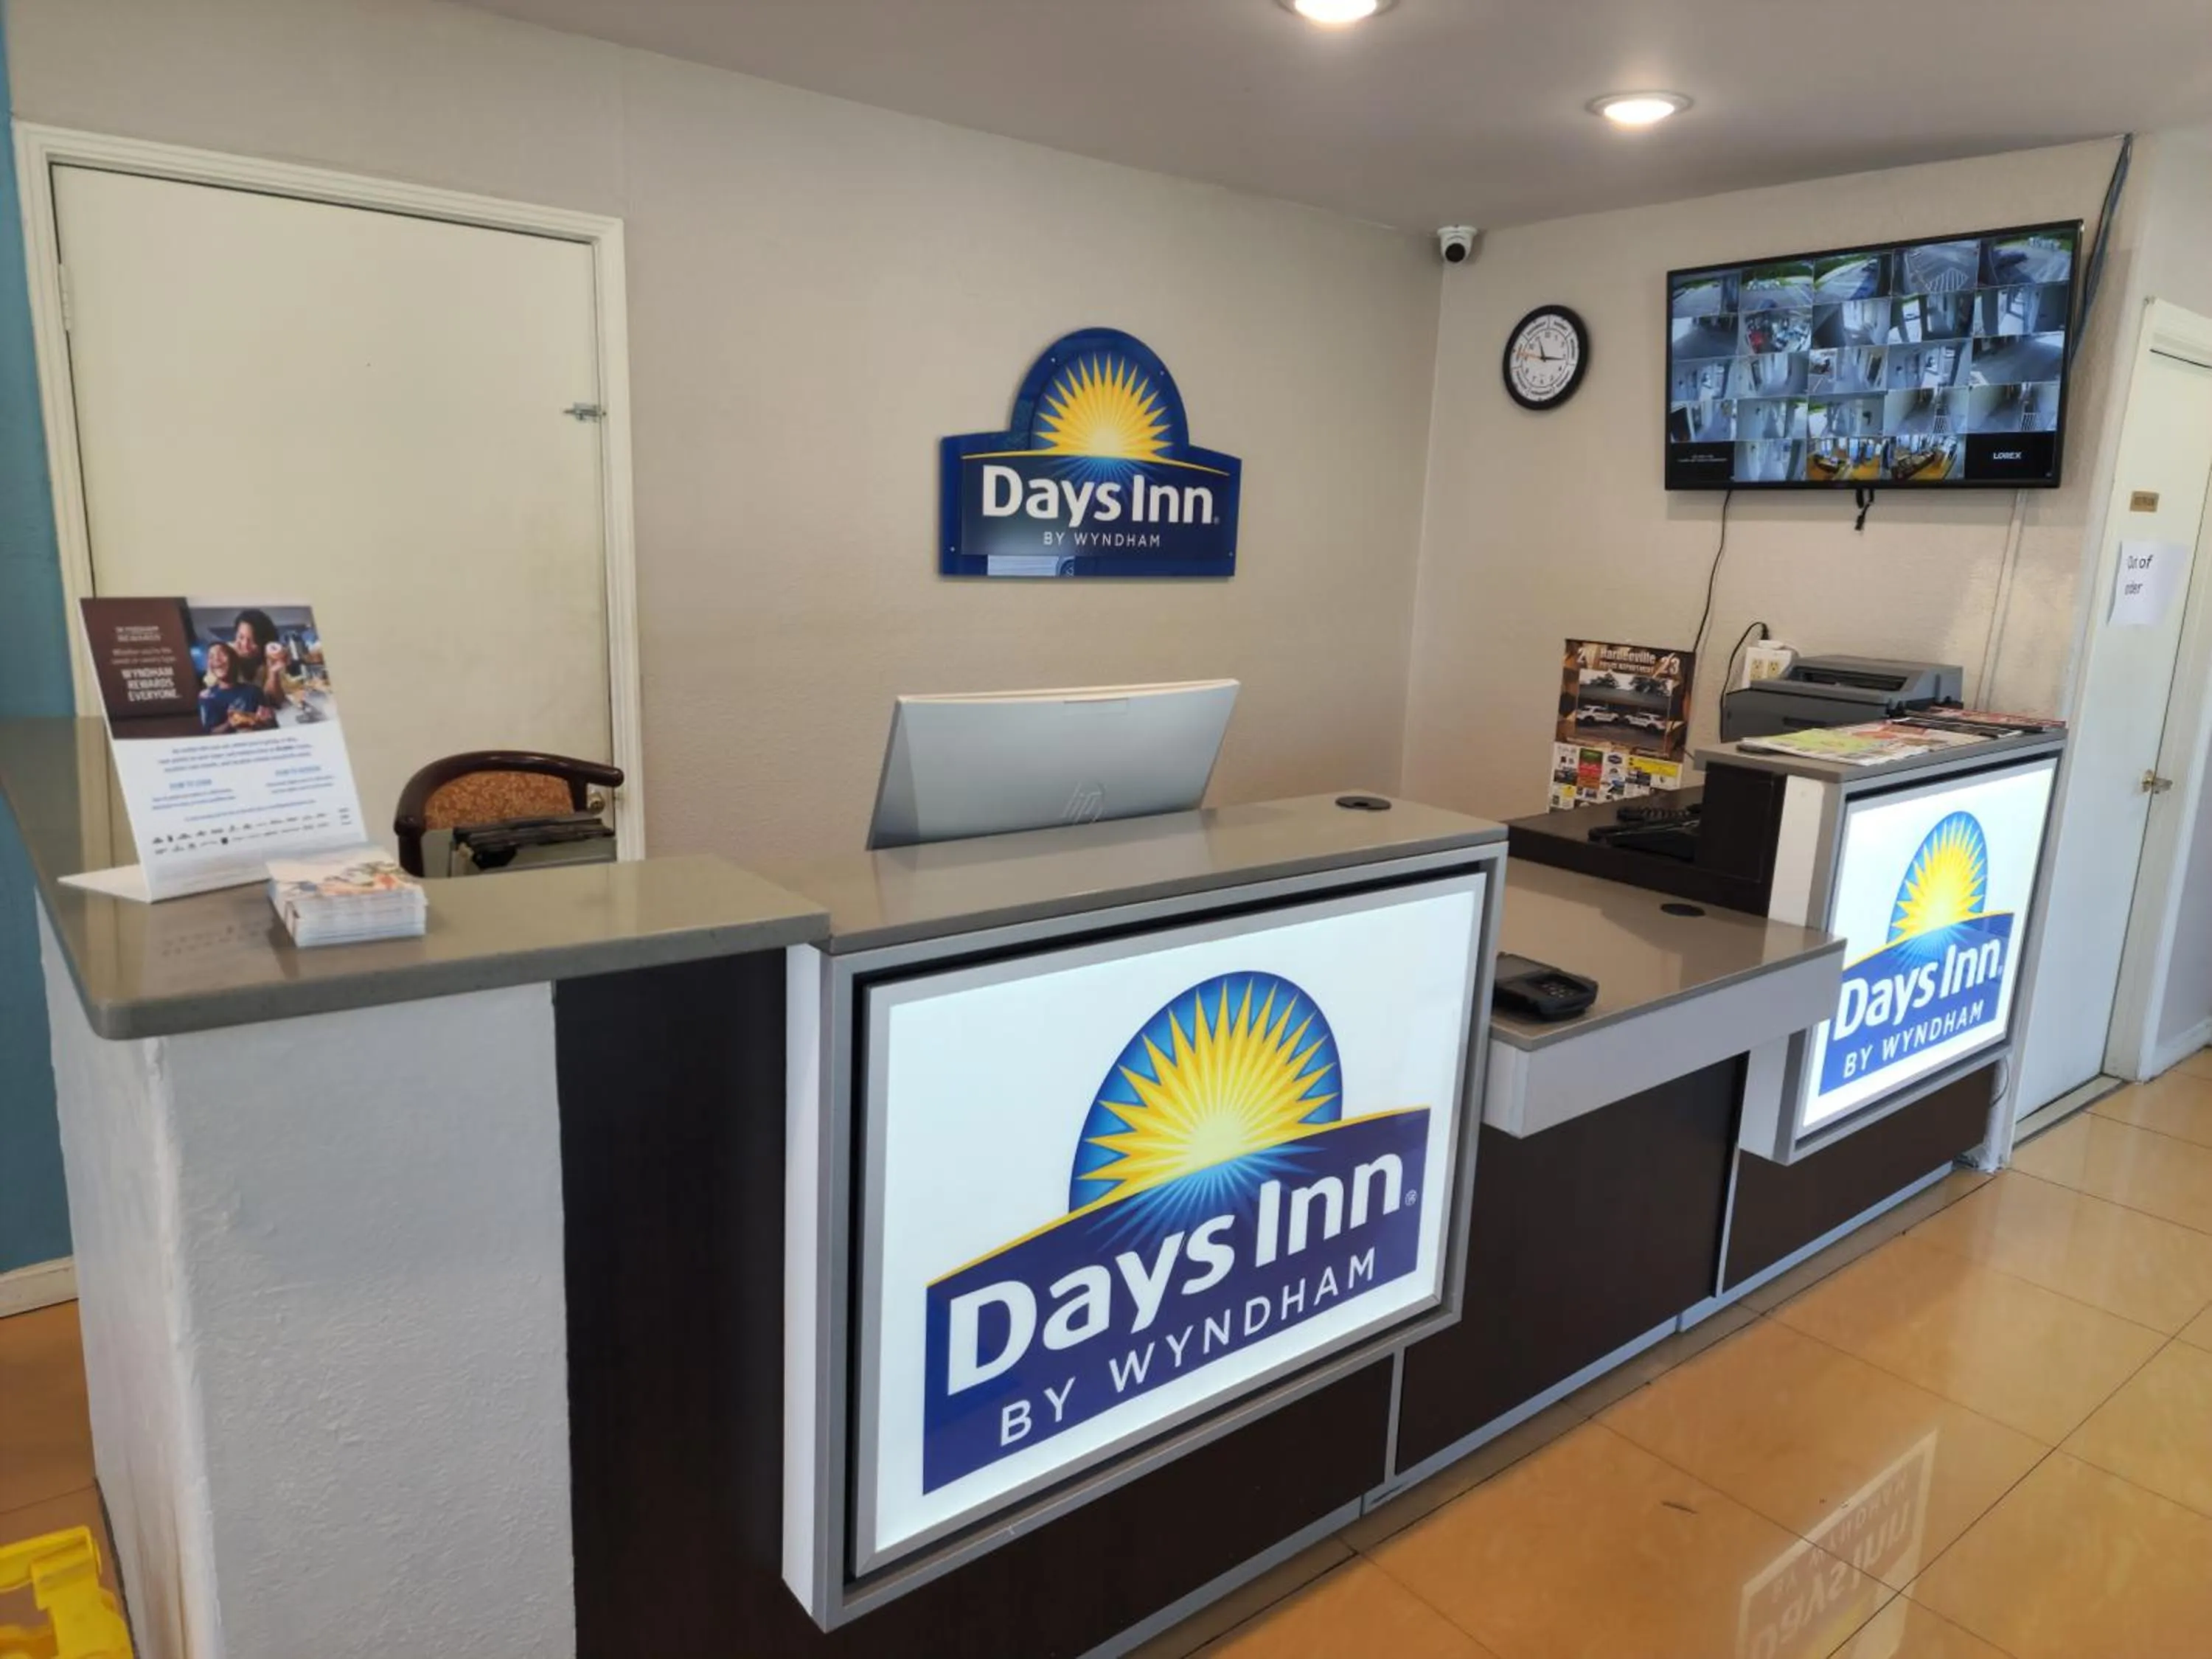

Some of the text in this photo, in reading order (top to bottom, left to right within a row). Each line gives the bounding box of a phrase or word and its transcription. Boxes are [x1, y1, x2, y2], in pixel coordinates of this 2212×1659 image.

[1992, 451, 2023, 460] LOREX
[982, 465, 1214, 528] Days Inn
[1043, 531, 1161, 548] BY WYNDHAM
[2139, 554, 2154, 569] of
[120, 667, 175, 679] WYNDHAM
[126, 678, 175, 690] REWARDS
[1833, 938, 2001, 1041] Days Inn
[1843, 1000, 1984, 1078] BY WYNDHAM
[947, 1154, 1403, 1396] Days Inn
[1000, 1248, 1376, 1447] BY WYNDHAM
